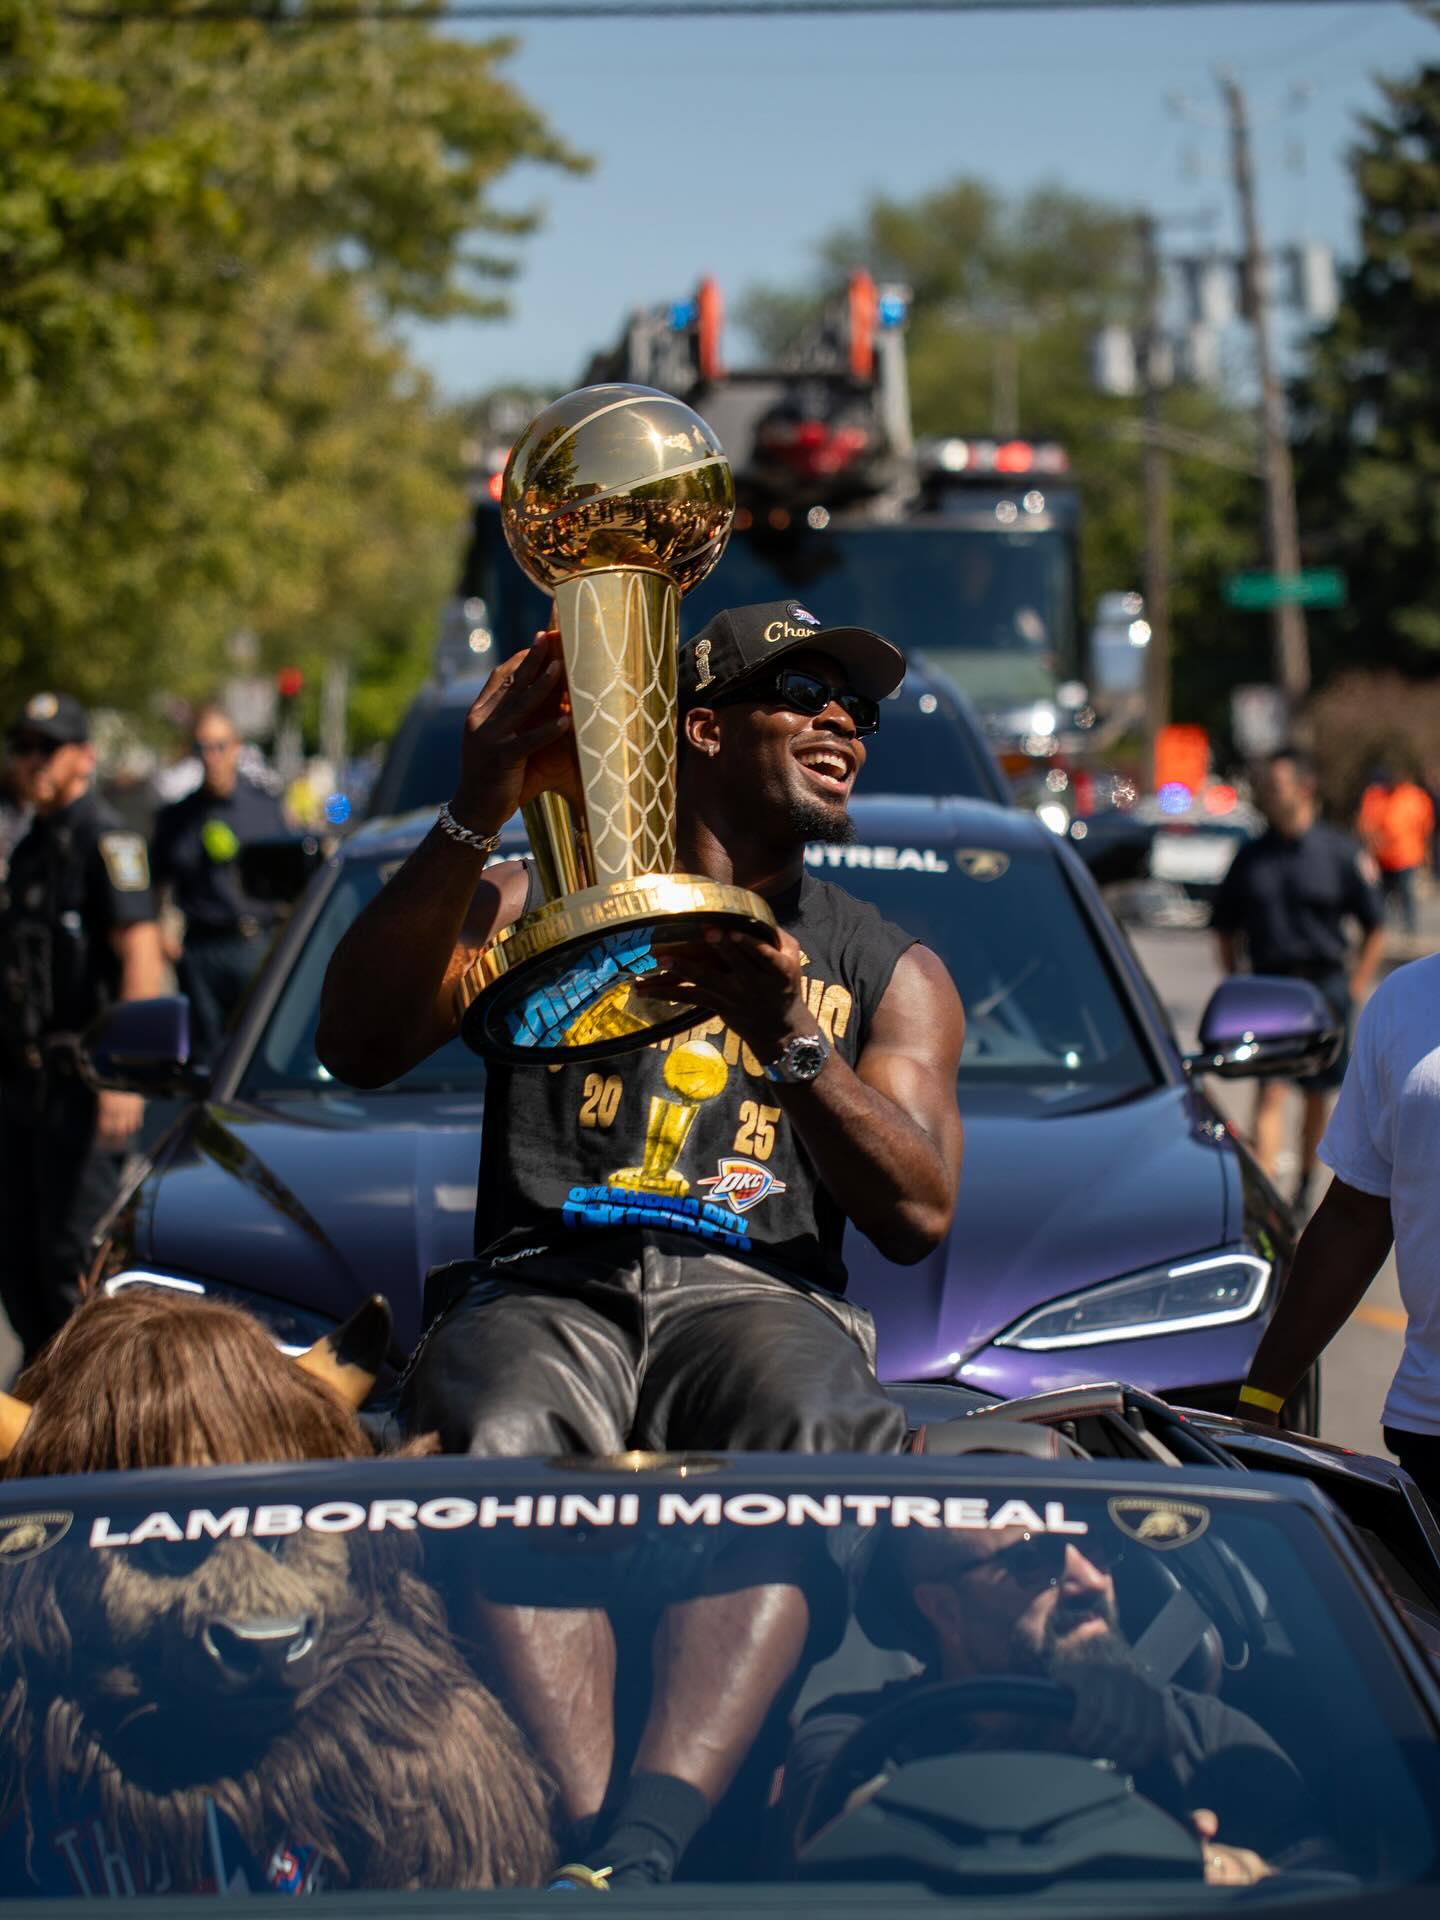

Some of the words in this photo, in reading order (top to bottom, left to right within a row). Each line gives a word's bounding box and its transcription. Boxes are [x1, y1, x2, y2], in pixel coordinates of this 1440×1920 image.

[803, 844, 949, 873] NTREAL
[579, 1073, 623, 1127] 20
[734, 1101, 781, 1160] 25
[712, 1172, 764, 1194] OKC
[568, 1185, 700, 1218] OKLAHOMA
[702, 1202, 749, 1235] CITY
[90, 1493, 640, 1548] LAMBORGHINI
[658, 1493, 1089, 1535] MONTREAL
